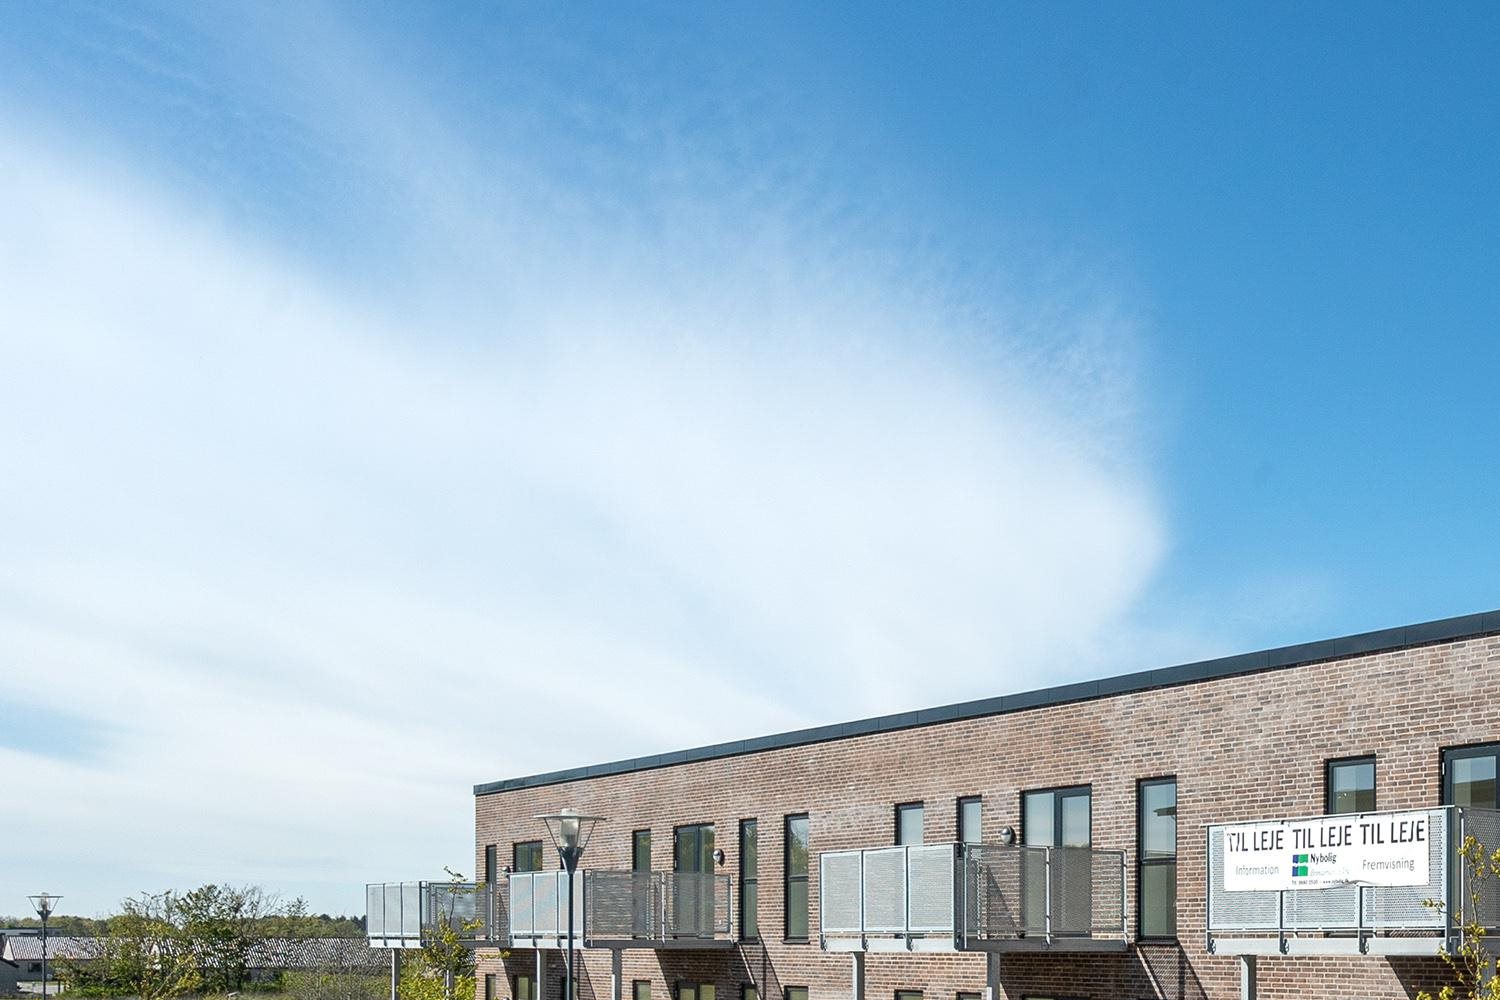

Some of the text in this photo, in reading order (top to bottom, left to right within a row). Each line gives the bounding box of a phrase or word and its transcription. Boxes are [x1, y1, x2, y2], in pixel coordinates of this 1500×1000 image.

[1227, 820, 1425, 852] TIL LEJE TIL LEJE TIL LEJE
[1310, 852, 1337, 864] Nybolig
[1362, 857, 1415, 871] Fremvisning
[1235, 864, 1280, 876] Information
